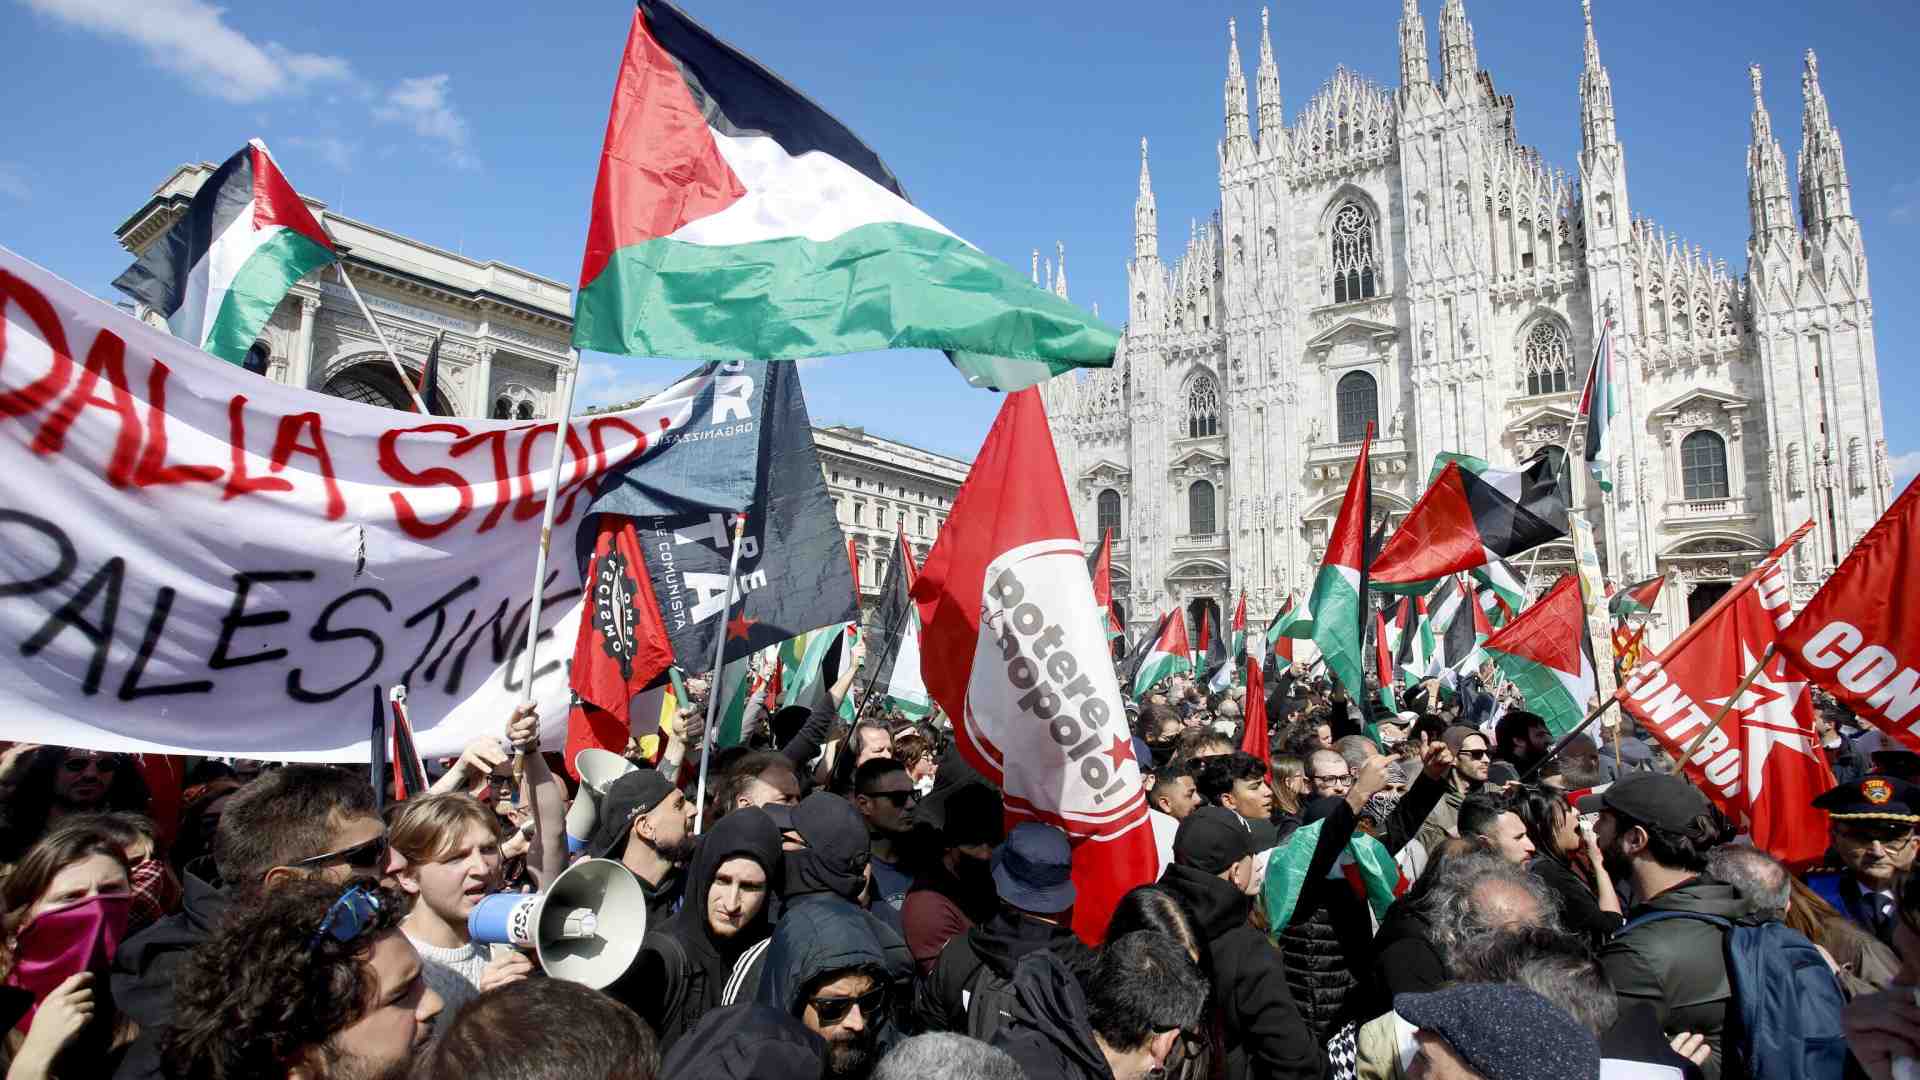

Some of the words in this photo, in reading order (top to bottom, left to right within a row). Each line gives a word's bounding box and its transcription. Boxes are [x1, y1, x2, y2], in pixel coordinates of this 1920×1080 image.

[0, 508, 582, 702] PALESTINE
[658, 541, 686, 631] COMUNISTA
[989, 567, 1111, 730] potere
[1801, 620, 1920, 738] CON
